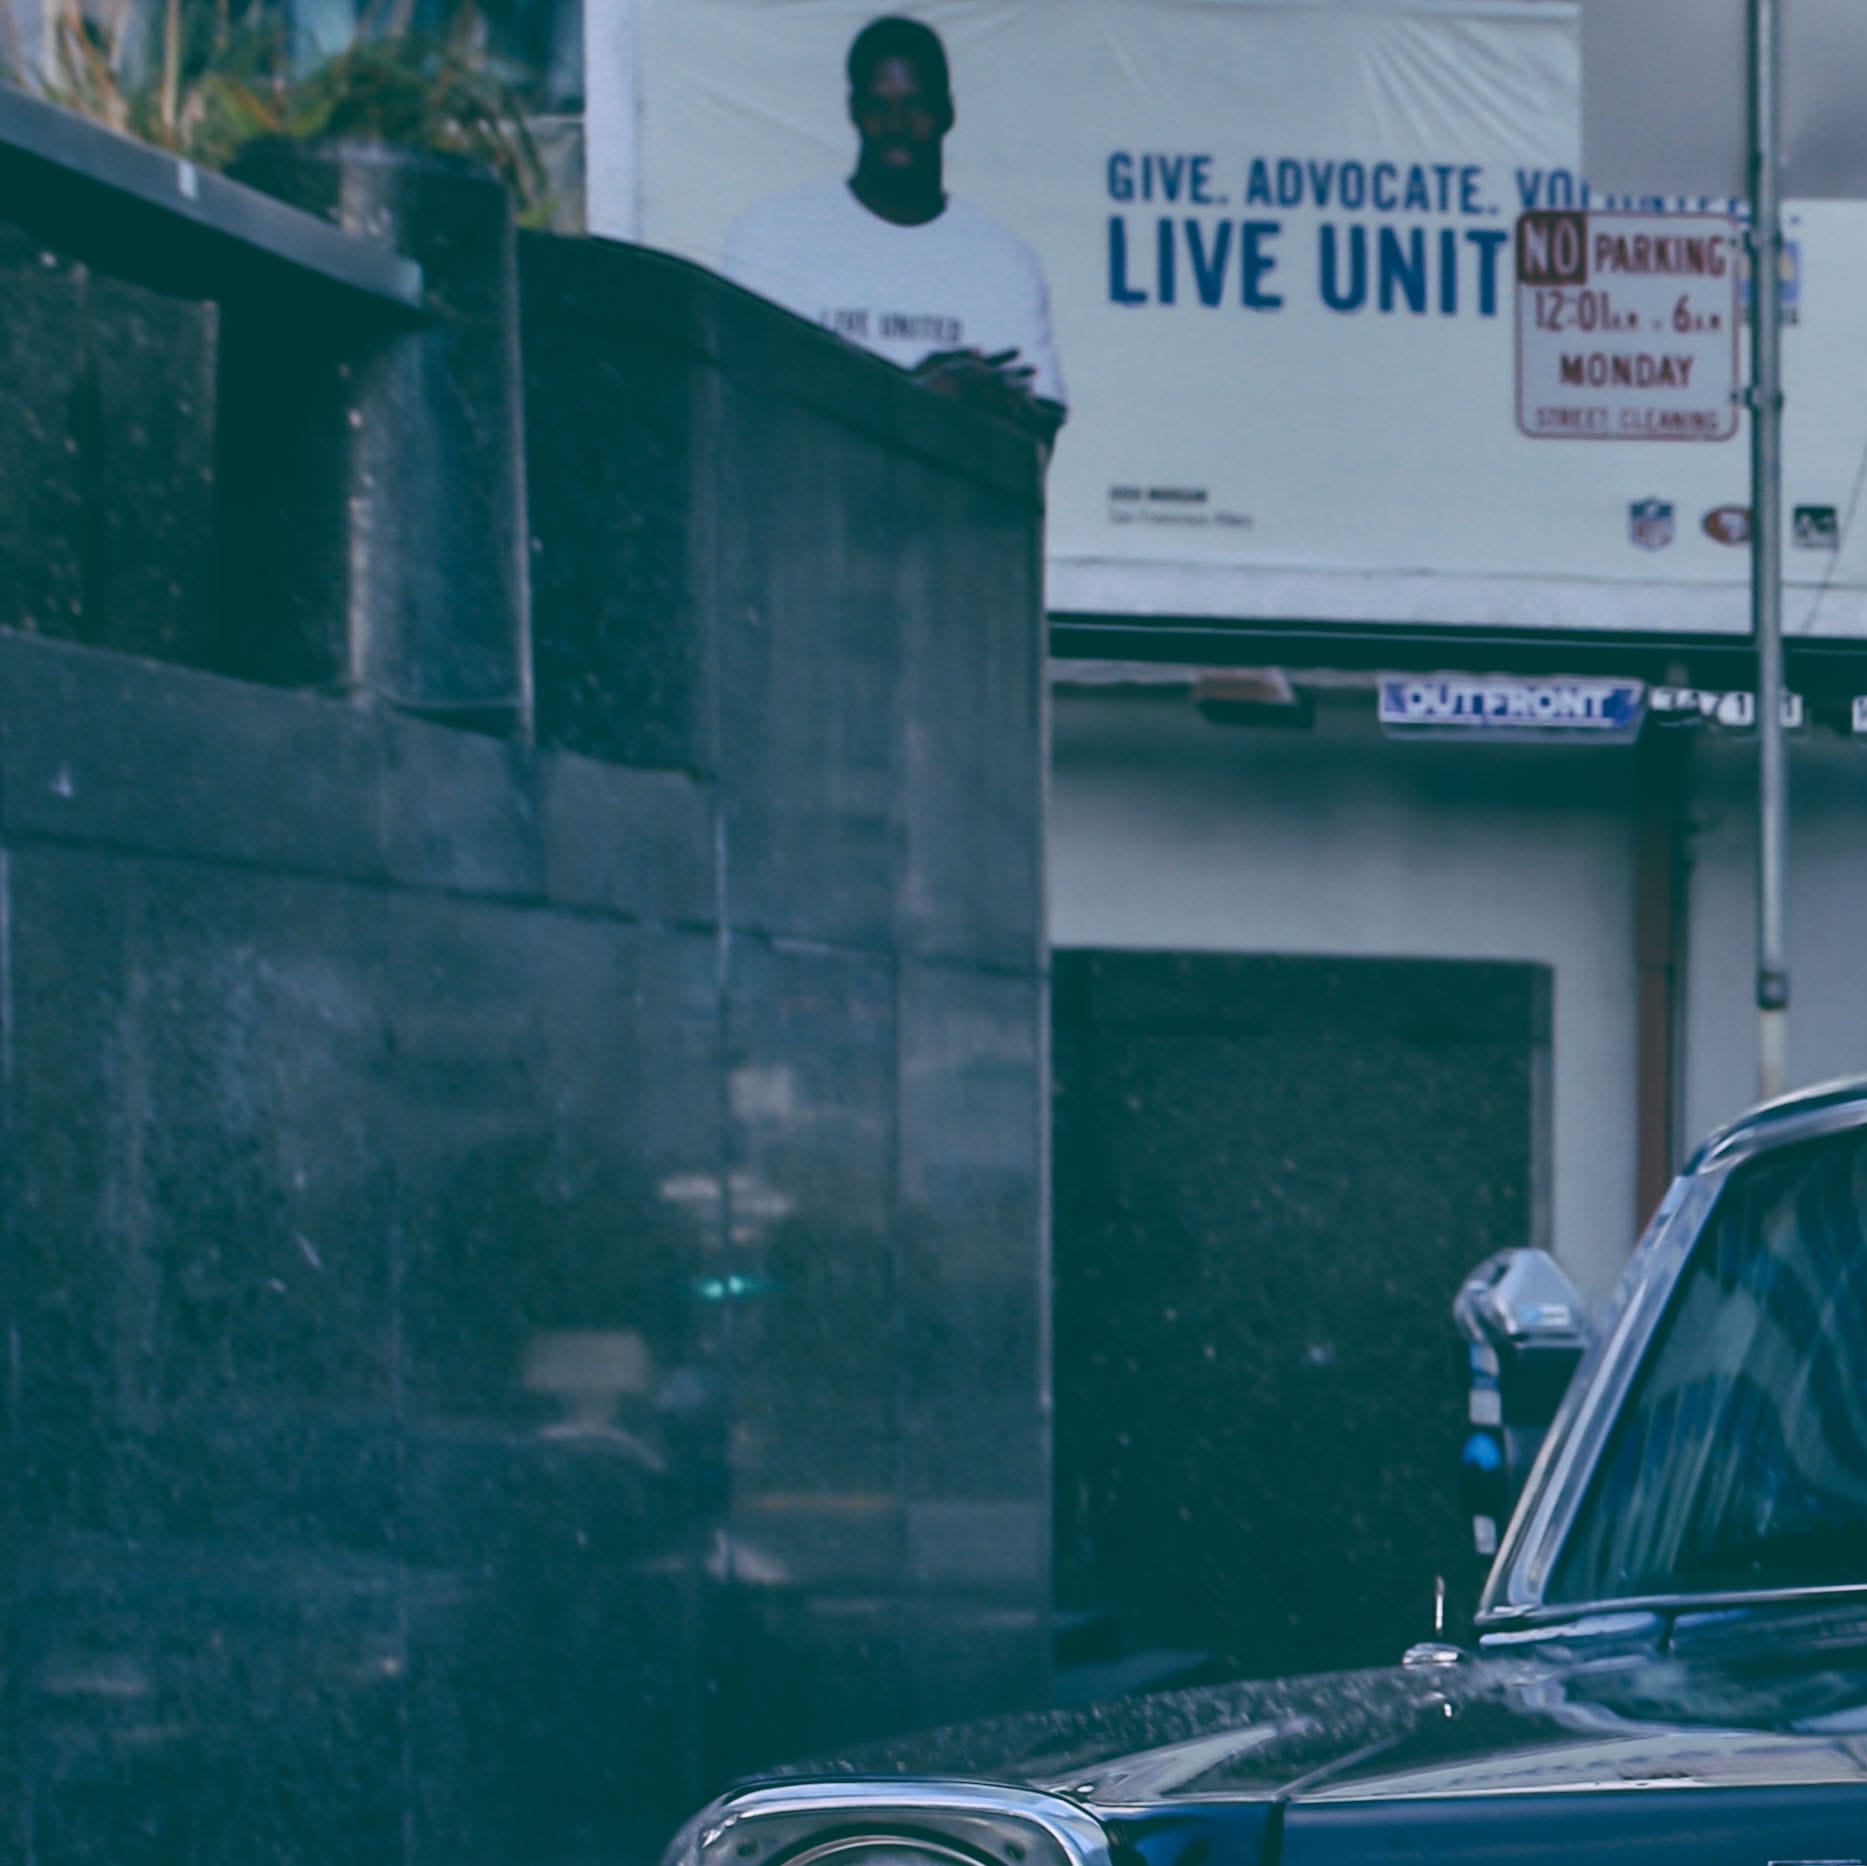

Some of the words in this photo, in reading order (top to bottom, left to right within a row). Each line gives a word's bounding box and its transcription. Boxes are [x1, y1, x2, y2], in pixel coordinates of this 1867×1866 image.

[1107, 152, 1228, 206] GIVE.
[1246, 156, 1499, 215] ADVOCATE.
[1108, 215, 1284, 308] LIVE
[1318, 223, 1509, 317] UNIT
[1524, 218, 1580, 277] NO
[1594, 233, 1727, 278] PARKING
[1559, 353, 1695, 388] MONDAY
[1535, 408, 1609, 430] STREET
[1619, 408, 1720, 432] CLEANING
[1404, 682, 1609, 719] OUTFRONT
